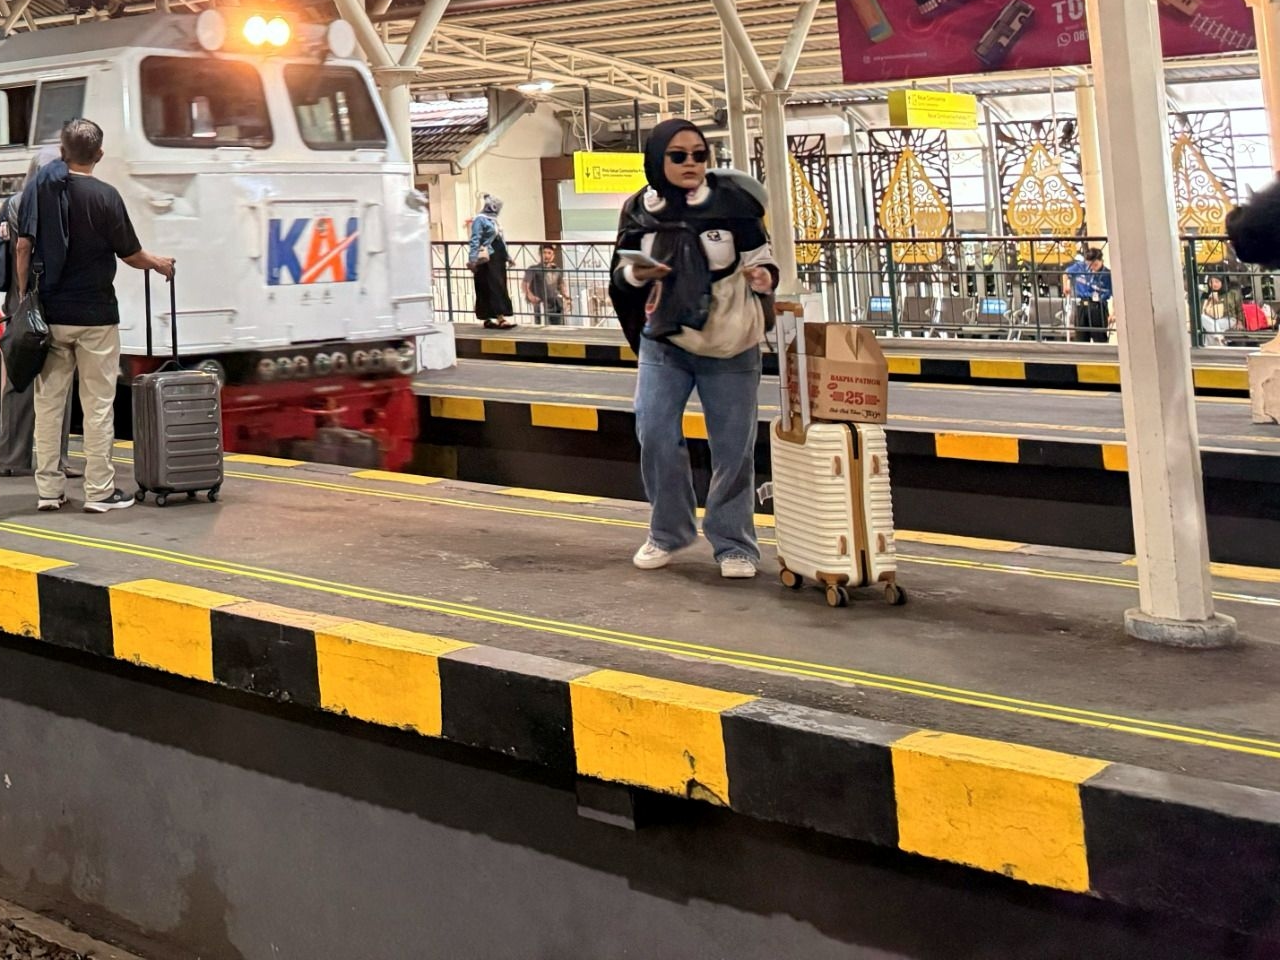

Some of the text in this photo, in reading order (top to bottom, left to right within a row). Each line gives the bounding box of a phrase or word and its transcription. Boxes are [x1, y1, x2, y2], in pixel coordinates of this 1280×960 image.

[267, 217, 359, 286] KAI
[830, 374, 854, 383] BAKPIA
[845, 390, 864, 405] 25
